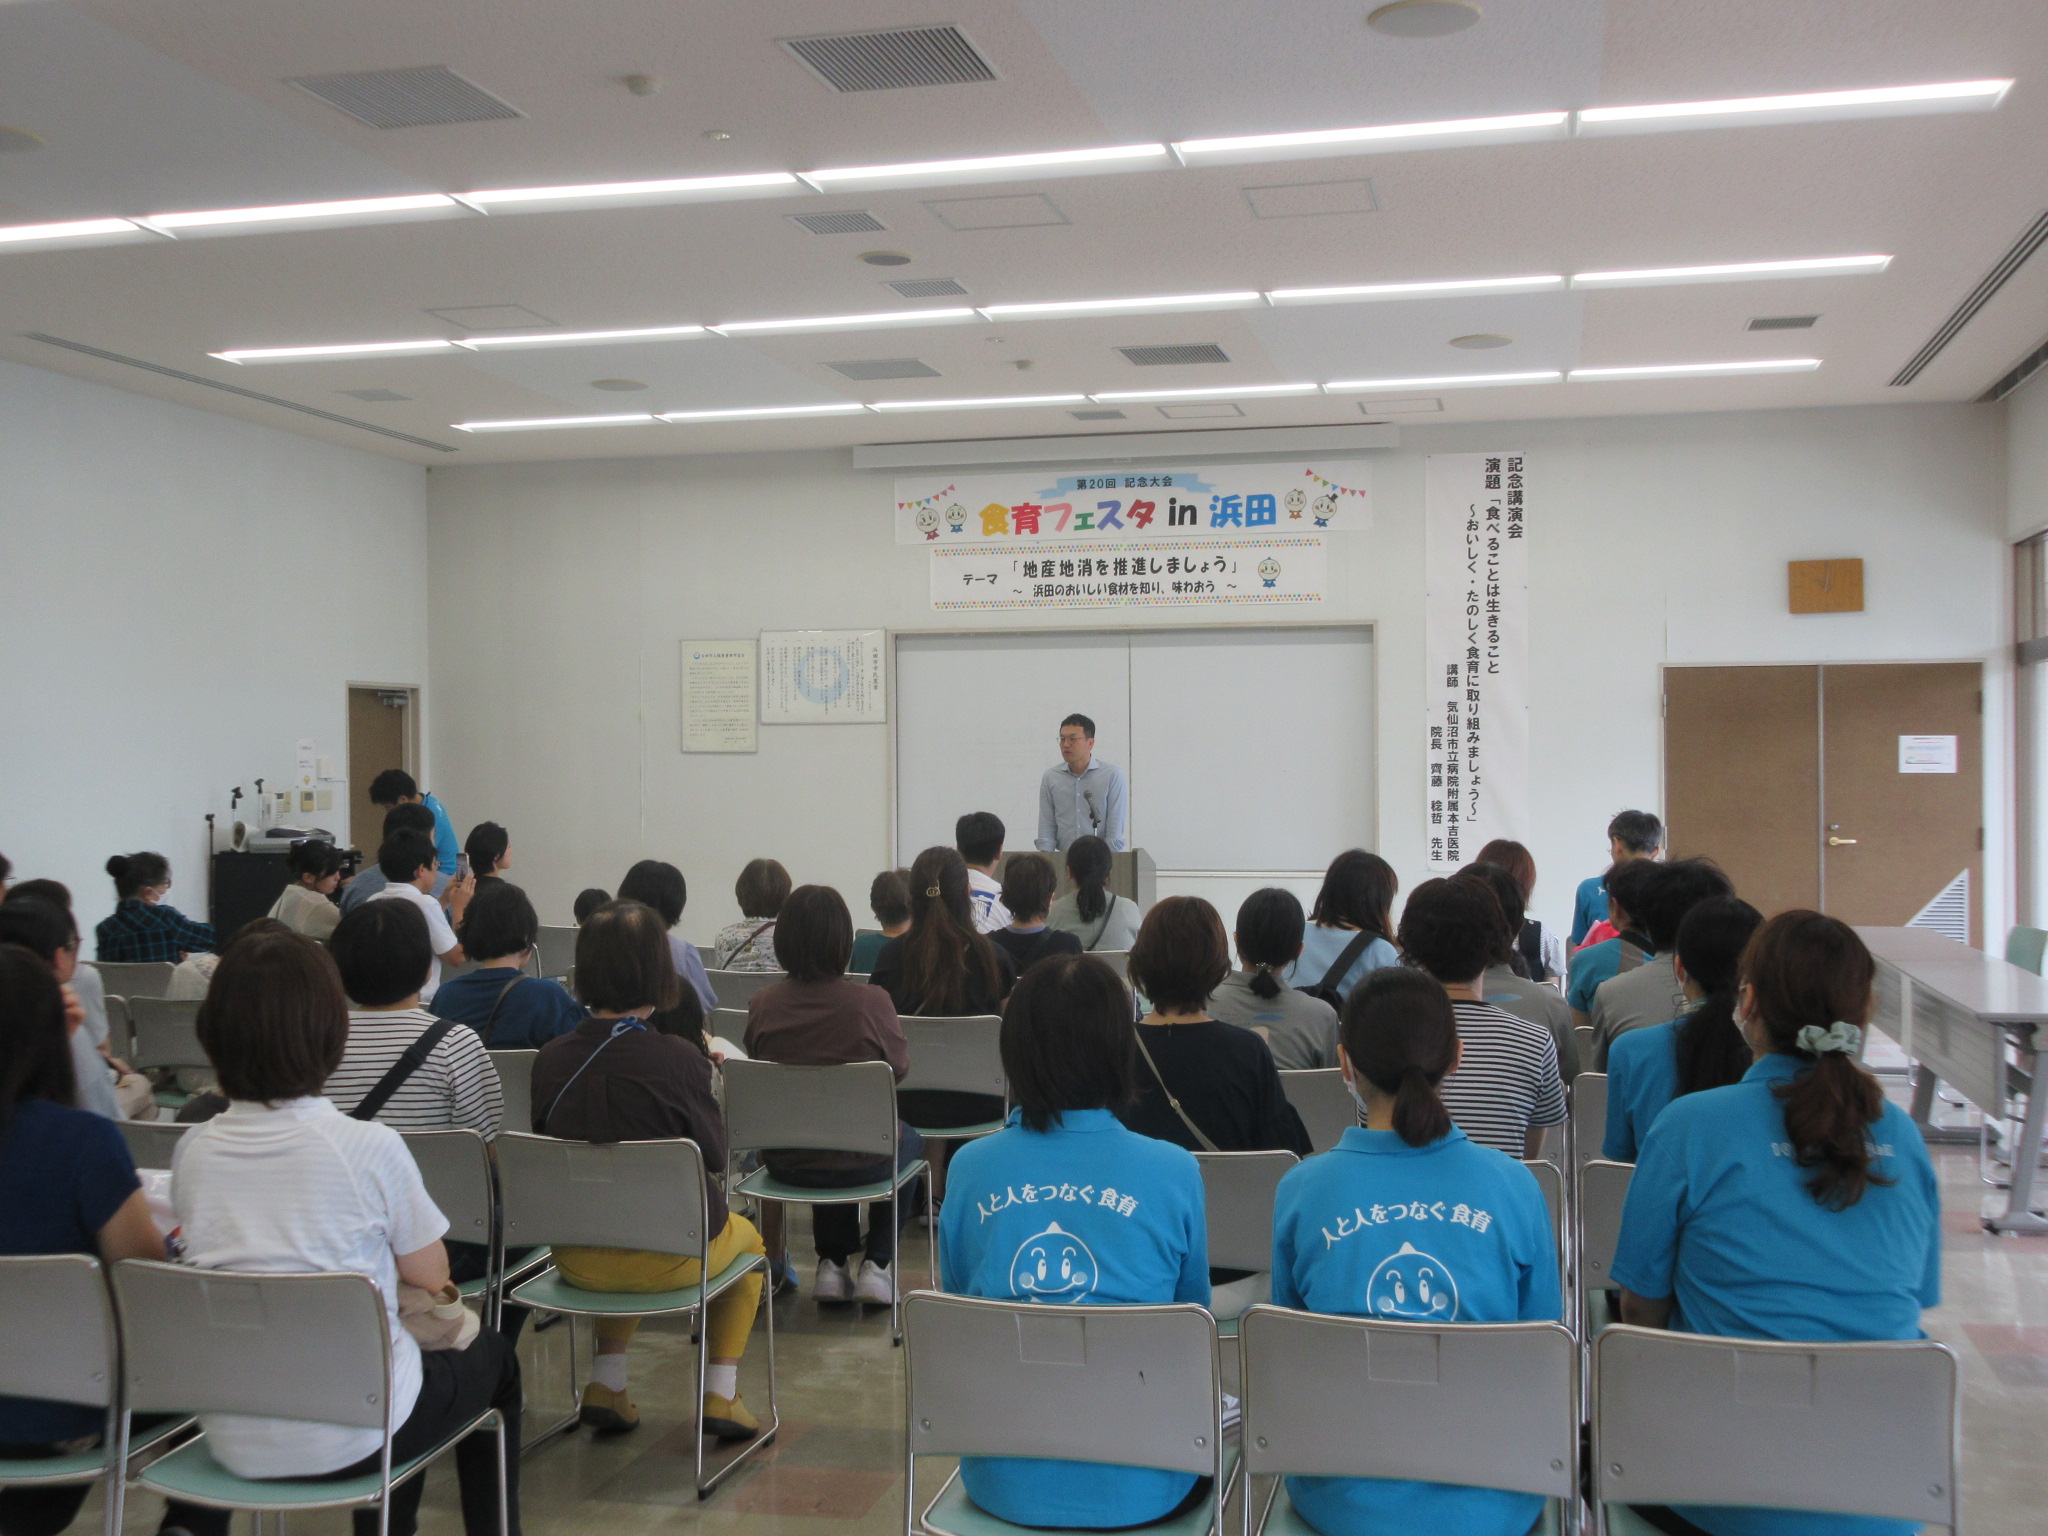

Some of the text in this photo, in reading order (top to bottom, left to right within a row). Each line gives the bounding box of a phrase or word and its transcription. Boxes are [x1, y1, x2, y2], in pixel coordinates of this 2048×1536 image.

[1077, 475, 1173, 490] 第20回 記念大会
[1507, 457, 1523, 539] 記念講演会
[978, 493, 1277, 537] 食育フェスタ in 浜田
[963, 573, 998, 585] テーマ
[1013, 555, 1237, 578] 「地産地消を推進しましょう」
[1430, 726, 1443, 750] 院長
[1446, 664, 1459, 861] 講師 気仙沼市立病院附属本吉医院
[1431, 837, 1443, 861] 先生
[977, 1183, 1139, 1224] 人と人をつなぐ 食育
[1322, 1201, 1492, 1250] 人と人をつなぐ 食育
